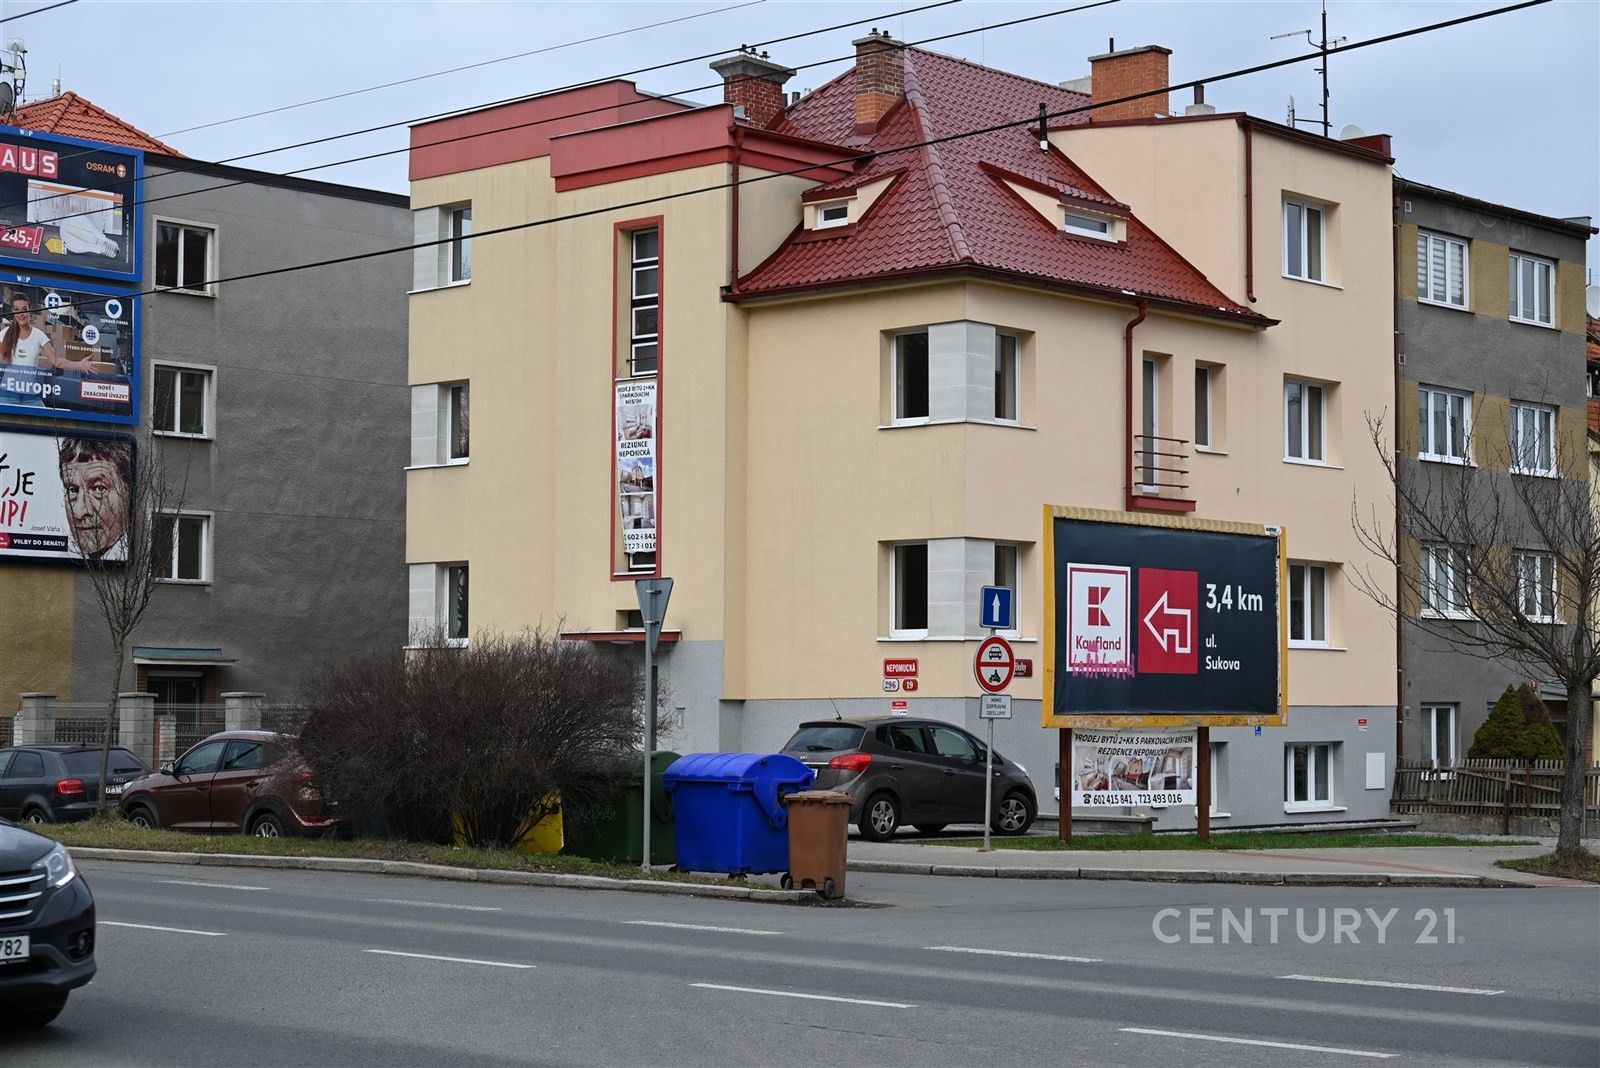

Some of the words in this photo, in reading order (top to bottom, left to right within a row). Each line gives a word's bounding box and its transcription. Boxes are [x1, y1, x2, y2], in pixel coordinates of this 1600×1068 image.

[1, 148, 56, 175] AUS
[86, 162, 115, 174] OSRAM
[0, 377, 61, 399] -Europe
[109, 392, 129, 400] ÚVAZKY
[10, 468, 35, 497] JE
[43, 539, 66, 547] SENÁTU
[627, 533, 639, 541] 602
[628, 542, 640, 550] 723
[1206, 583, 1233, 613] 3,4
[1238, 585, 1263, 611] km
[1075, 636, 1122, 651] Kaufland
[1206, 634, 1217, 648] ul.
[886, 662, 916, 673] NEPOMUCKÁ
[1206, 655, 1240, 671] Sukova
[884, 680, 897, 690] 296
[906, 680, 914, 690] 19
[1074, 733, 1101, 744] PRODEJ
[1100, 734, 1118, 745] BYTŮ
[1118, 736, 1135, 745] 2+KK
[1135, 736, 1140, 745] S
[1140, 735, 1174, 746] PARKOVACÍM
[1097, 746, 1133, 757] REZIDENCE
[1133, 747, 1168, 758] NEPOMUCKÁ
[1093, 794, 1106, 805] 602
[1106, 794, 1120, 805] 415
[1120, 794, 1133, 805] 841
[1138, 794, 1151, 804] 723
[1152, 794, 1166, 804] 493
[1167, 793, 1183, 804] 016
